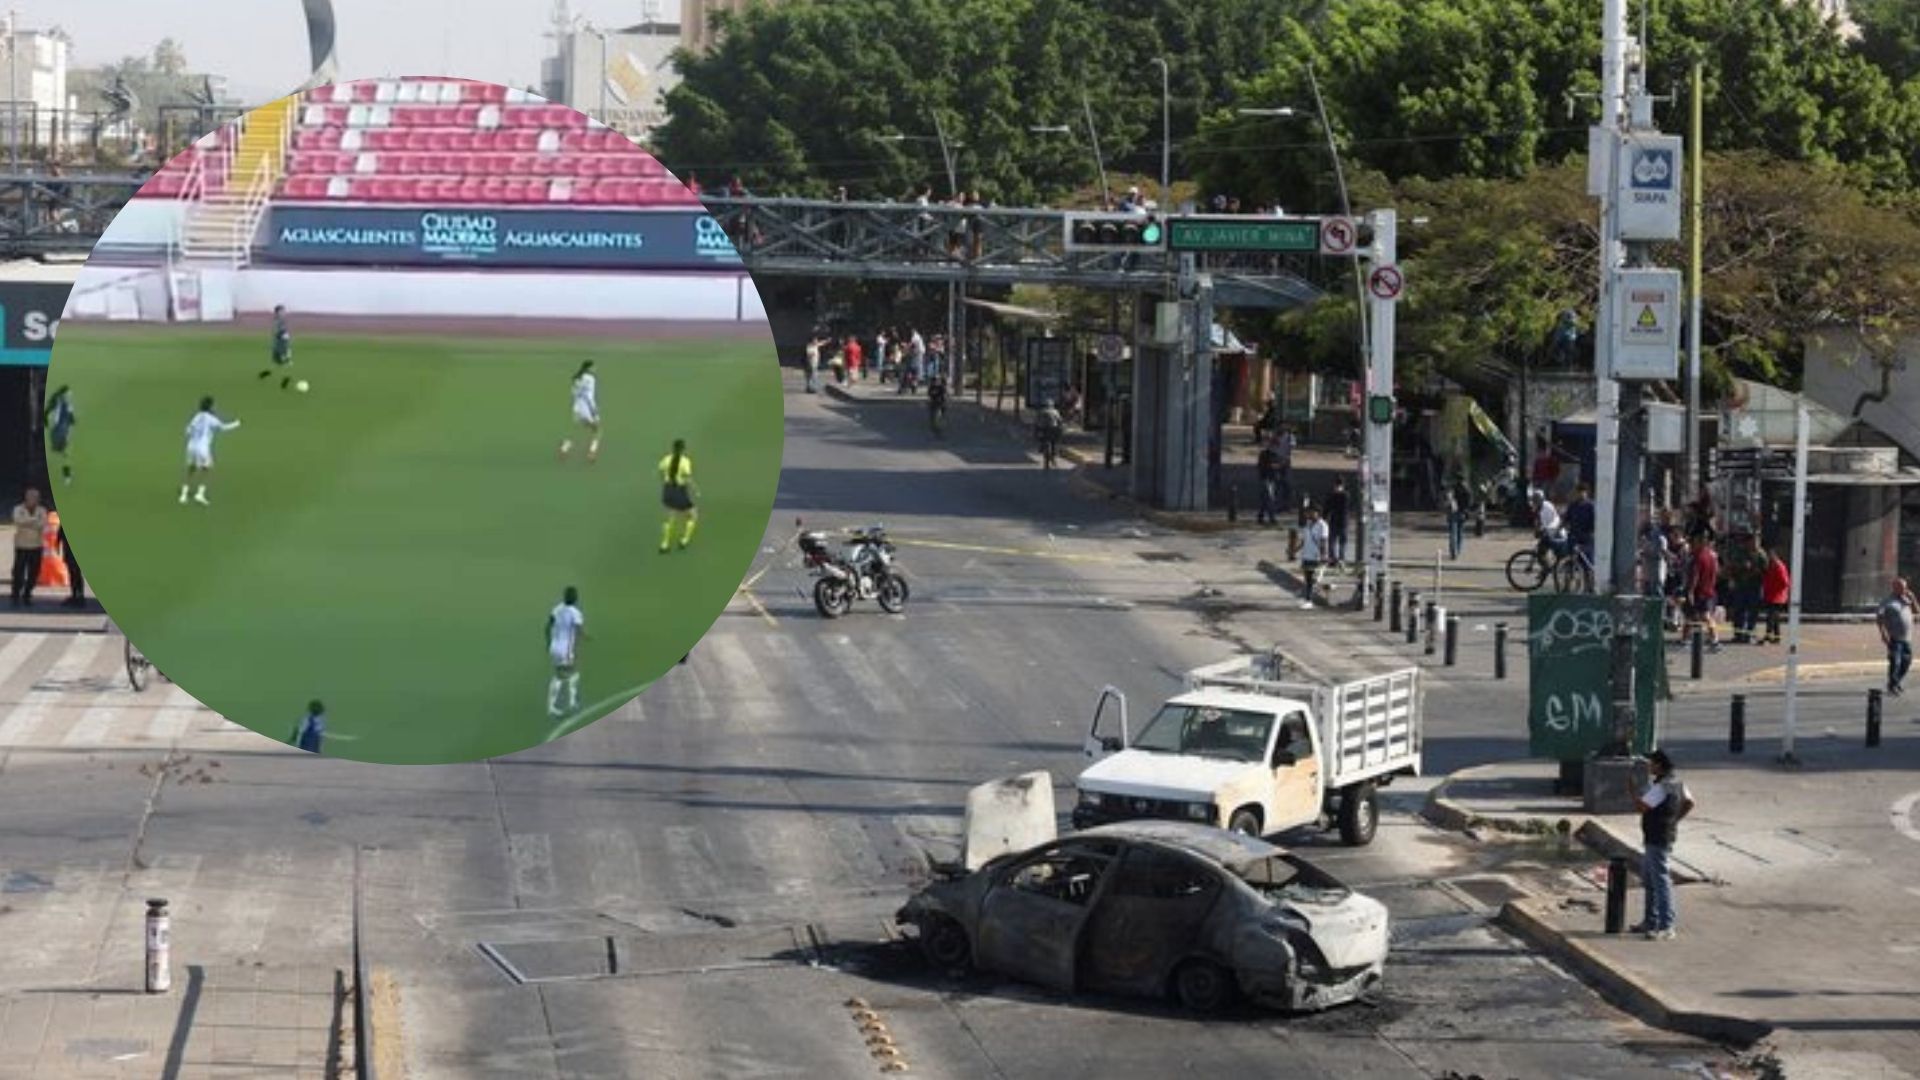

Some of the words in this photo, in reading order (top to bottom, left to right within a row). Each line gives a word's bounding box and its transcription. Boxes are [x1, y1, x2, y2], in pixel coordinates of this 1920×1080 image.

[422, 213, 496, 231] CIUDAD
[281, 228, 416, 244] AGUASCALIENTES
[423, 231, 496, 245] MADERAS
[503, 230, 643, 247] AGUASCALIENTES
